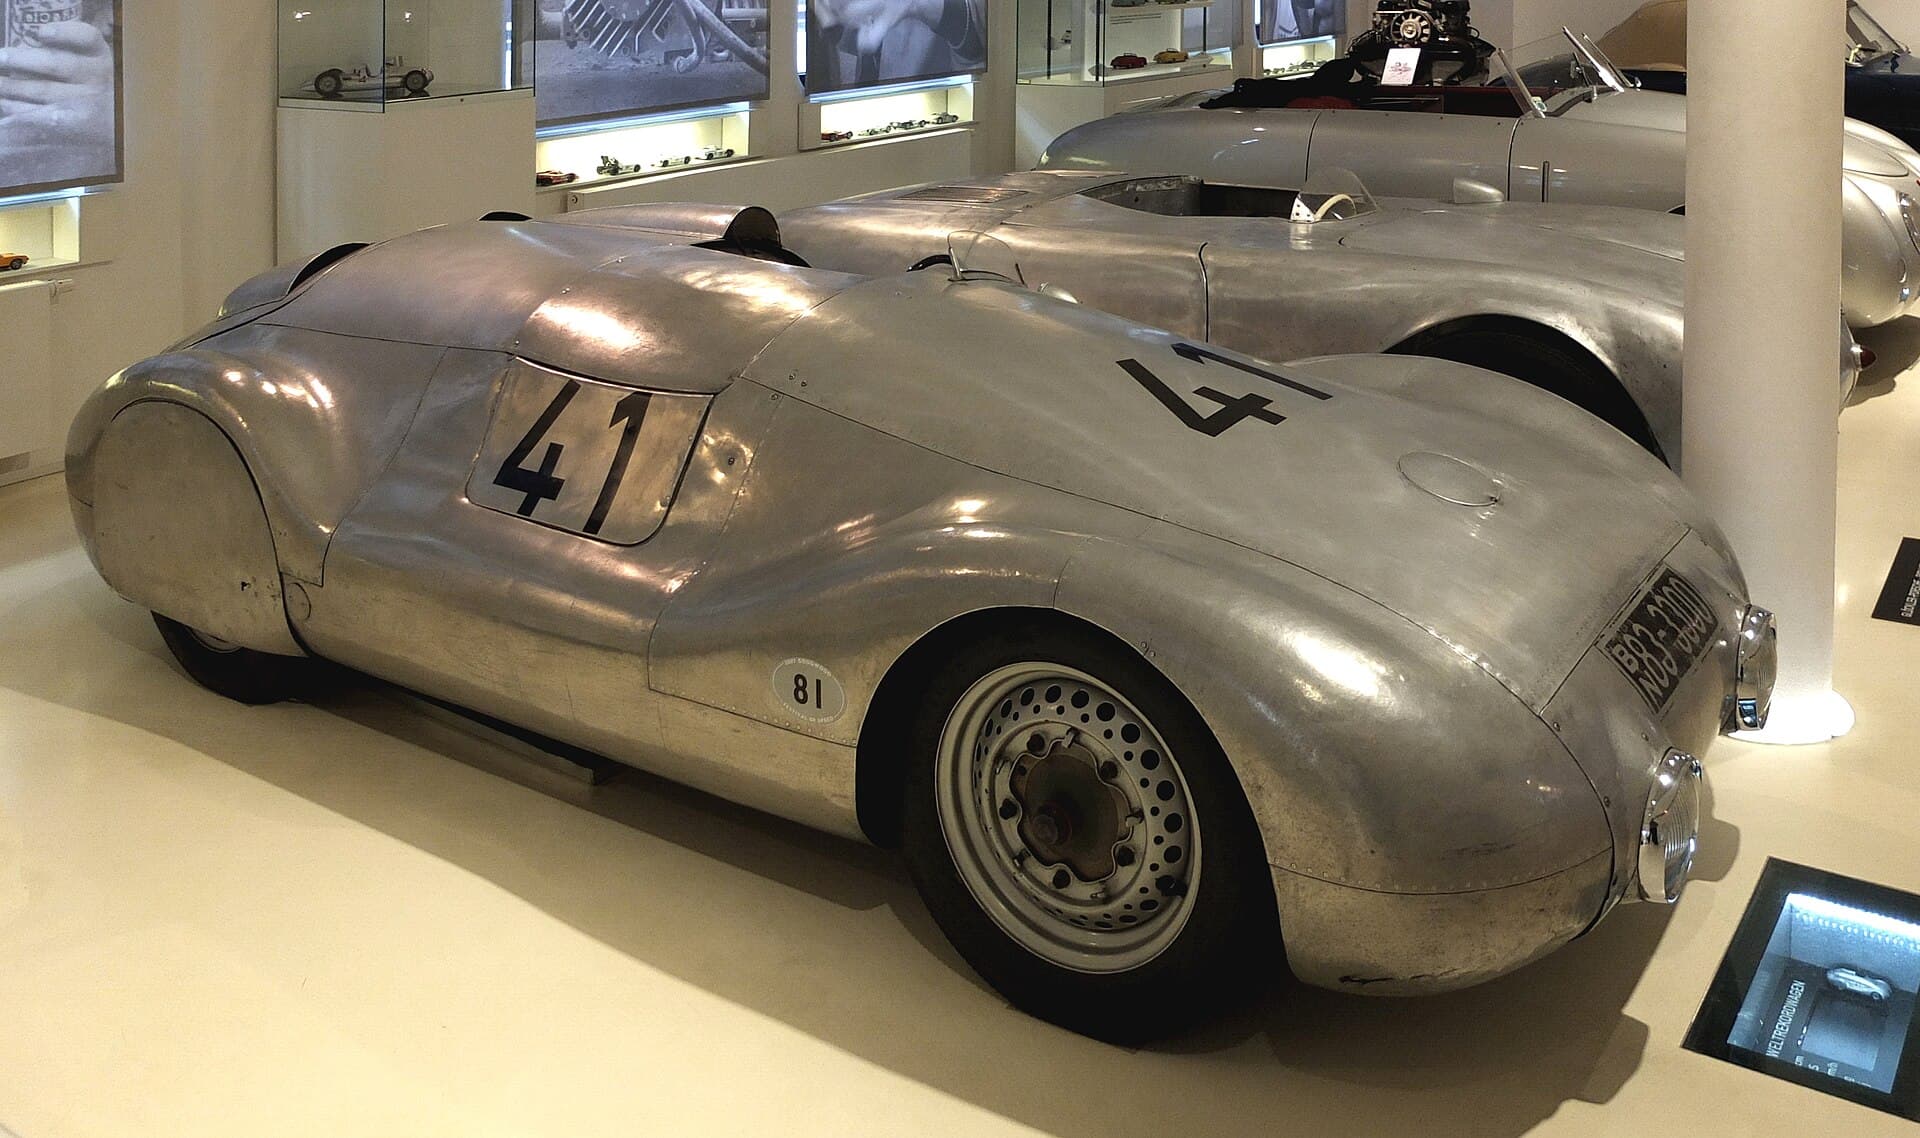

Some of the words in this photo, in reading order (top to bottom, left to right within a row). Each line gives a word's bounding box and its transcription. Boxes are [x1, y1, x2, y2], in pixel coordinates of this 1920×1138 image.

[1116, 343, 1333, 437] 41
[493, 379, 654, 535] 41
[793, 673, 822, 709] 81
[1765, 980, 1806, 1057] WELTREKORDWAGEN
